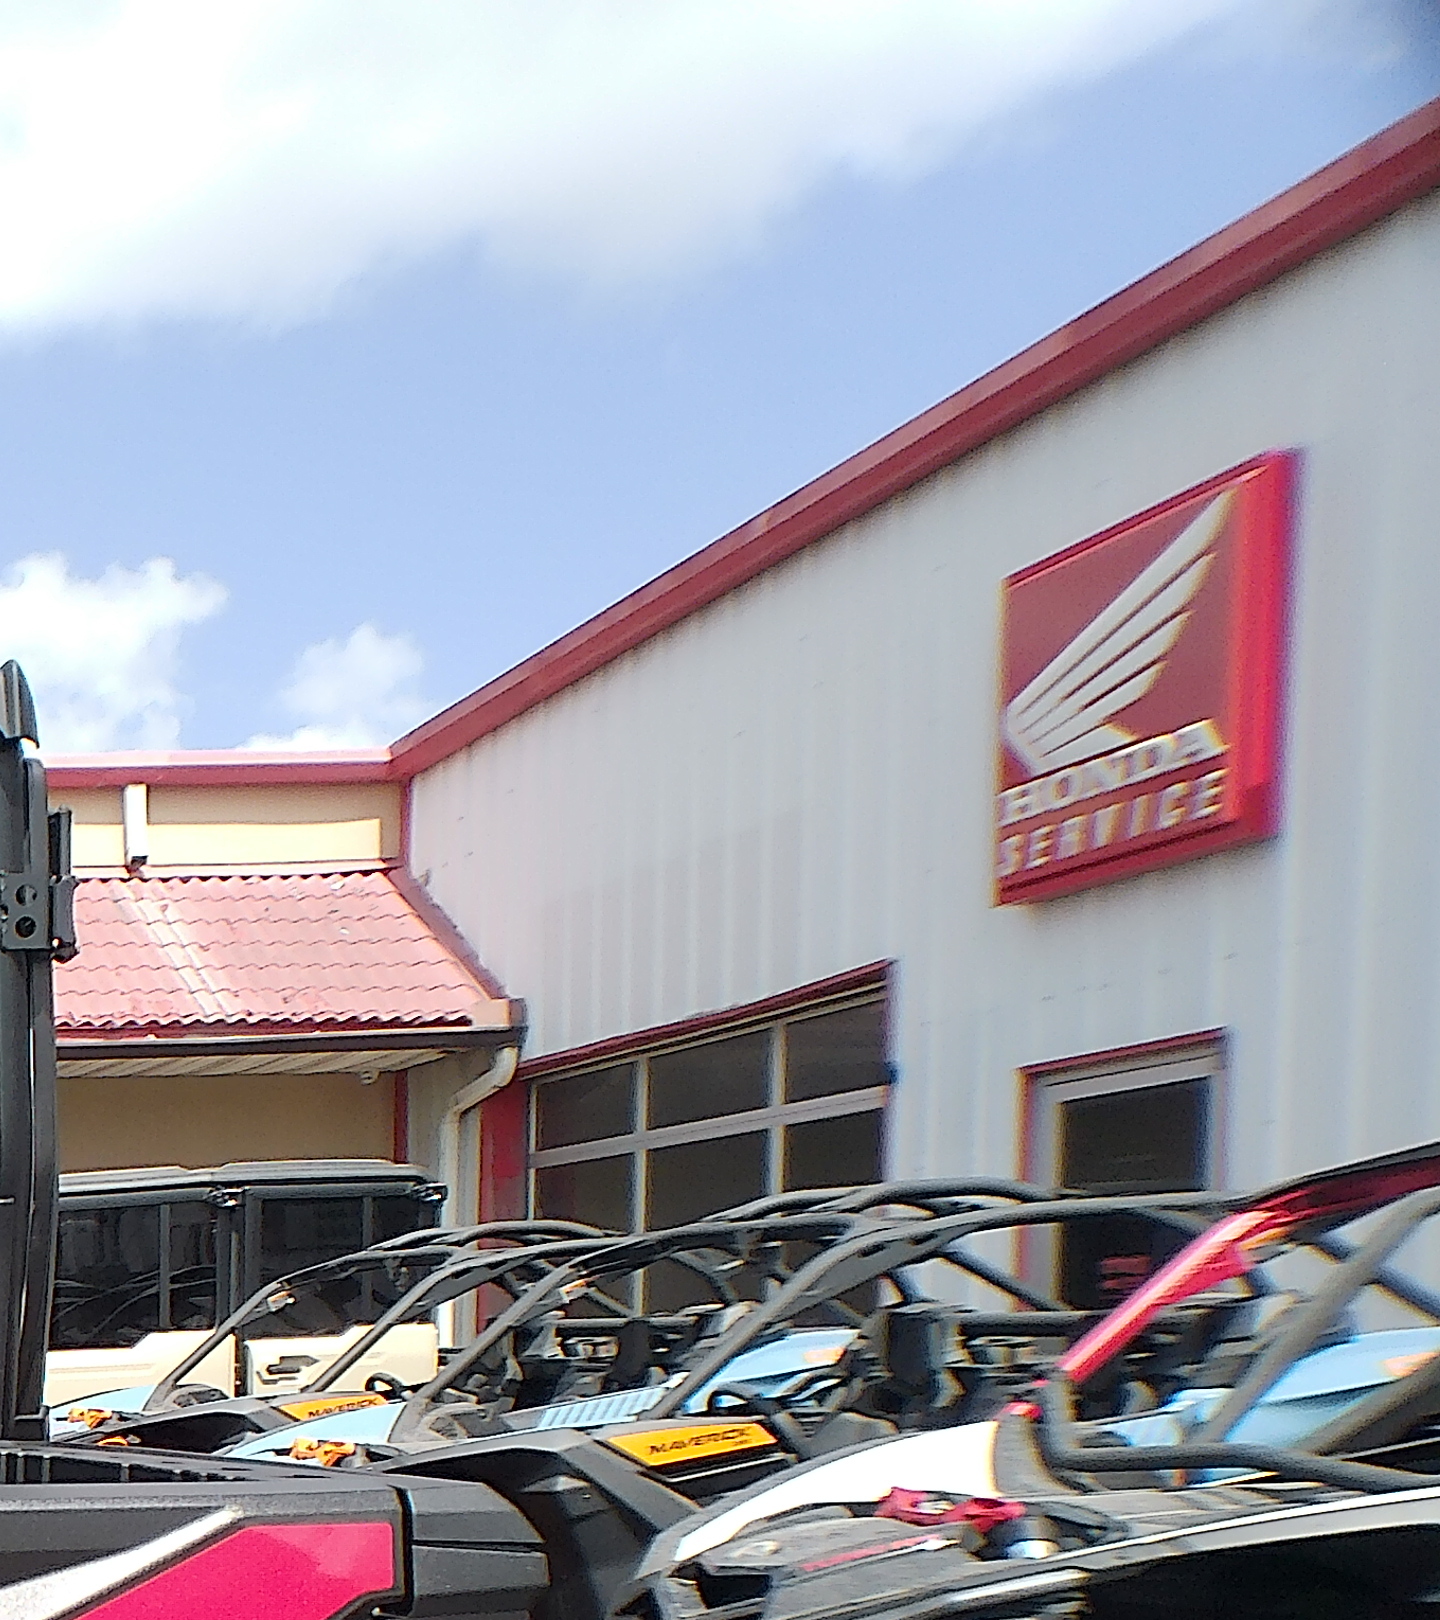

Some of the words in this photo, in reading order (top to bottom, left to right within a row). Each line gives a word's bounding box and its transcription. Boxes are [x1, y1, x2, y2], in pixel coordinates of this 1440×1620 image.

[997, 717, 1231, 827] HONDA
[995, 768, 1228, 878] SERVICE
[307, 1398, 378, 1418] MAVERICK
[648, 1427, 751, 1455] MAVERICK
